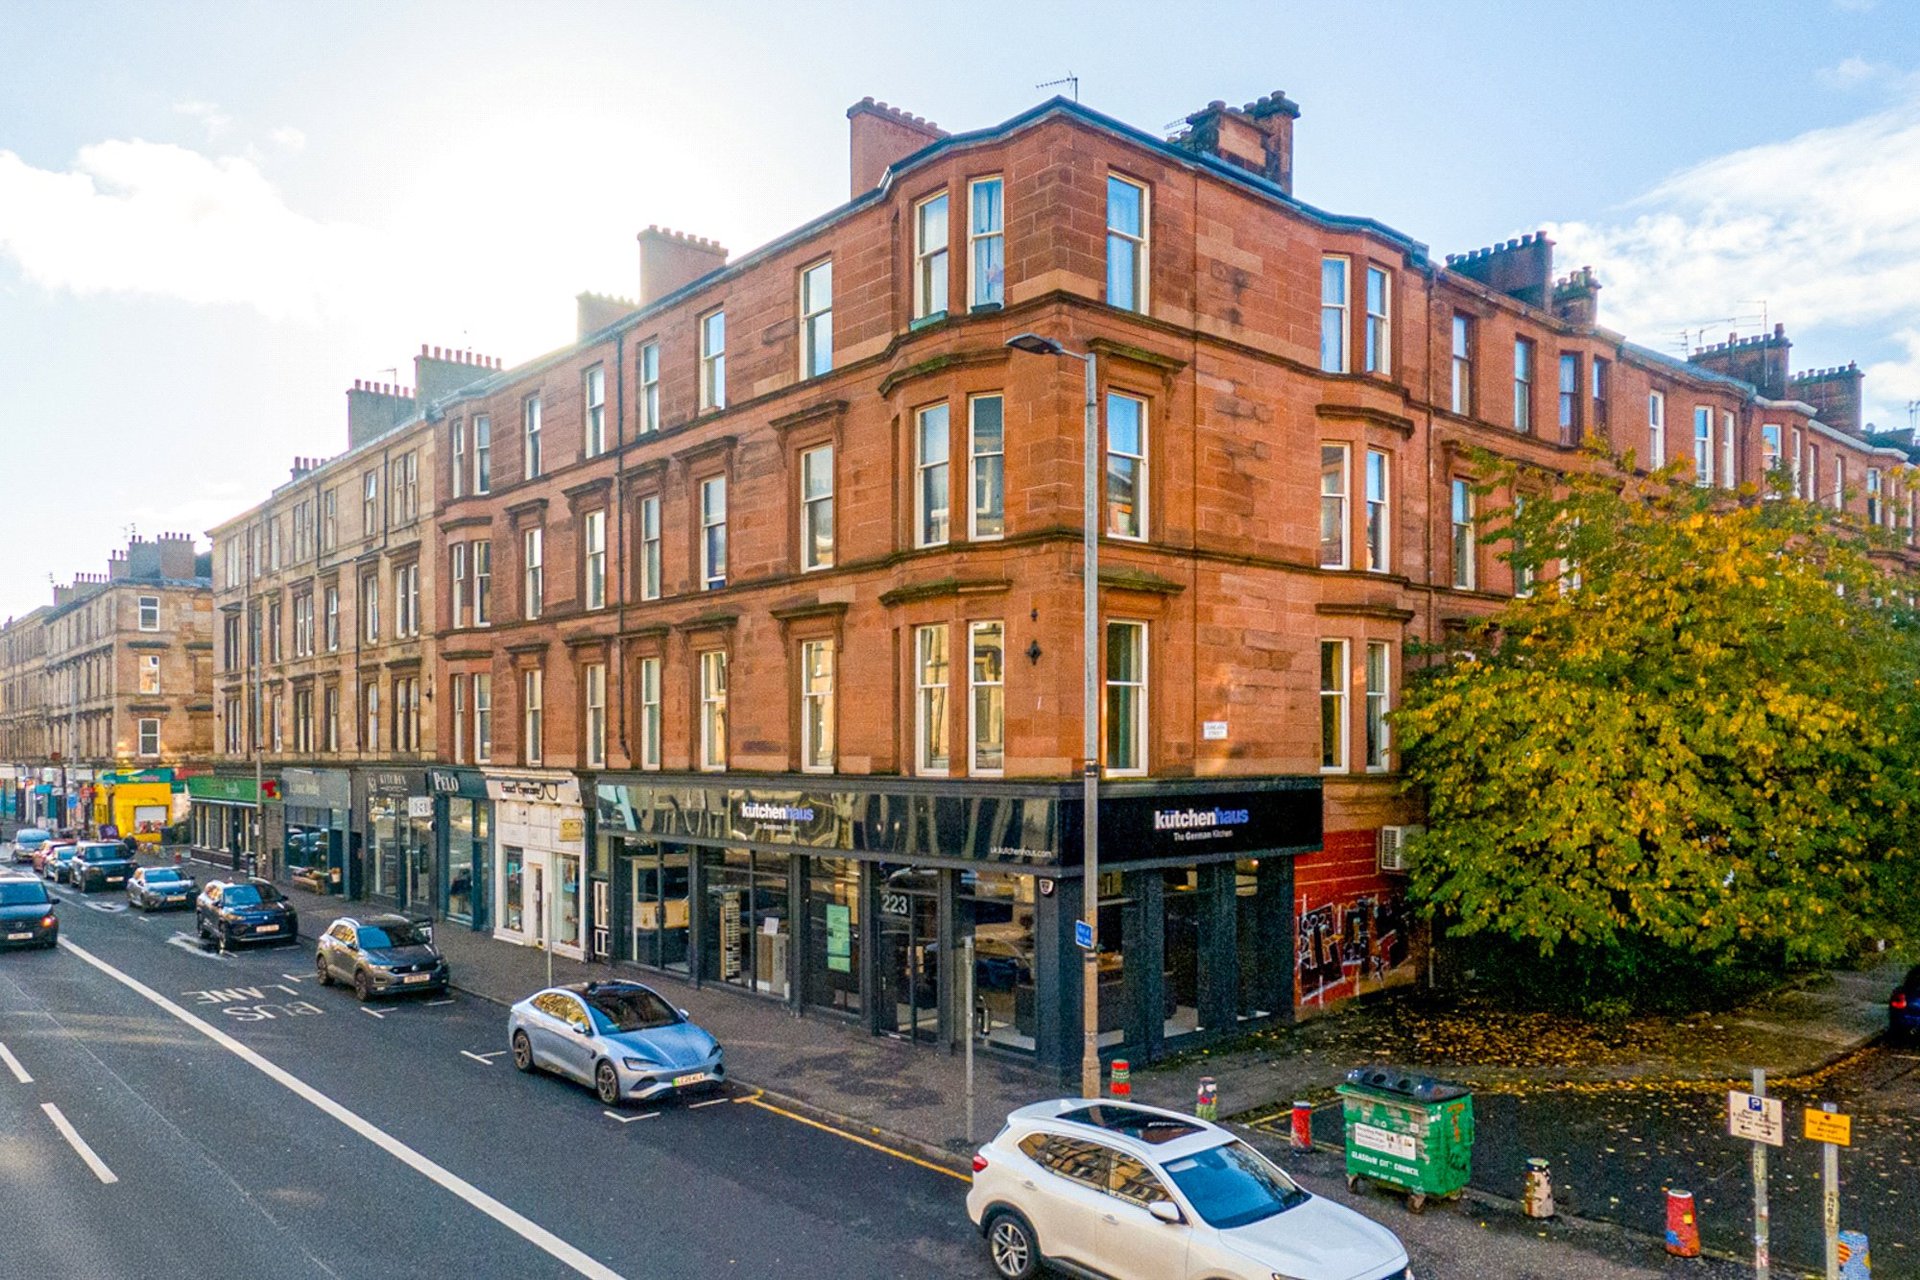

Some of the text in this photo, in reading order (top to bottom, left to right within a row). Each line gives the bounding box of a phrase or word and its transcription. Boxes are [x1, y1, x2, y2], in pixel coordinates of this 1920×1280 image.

[433, 772, 459, 792] PELO
[741, 802, 814, 821] kütchenhaus
[1154, 806, 1249, 829] kütchenhaus
[1185, 831, 1212, 841] German
[881, 894, 908, 914] 223
[181, 984, 299, 1004] LANE
[223, 1001, 324, 1021] BUS
[1751, 1098, 1761, 1109] P
